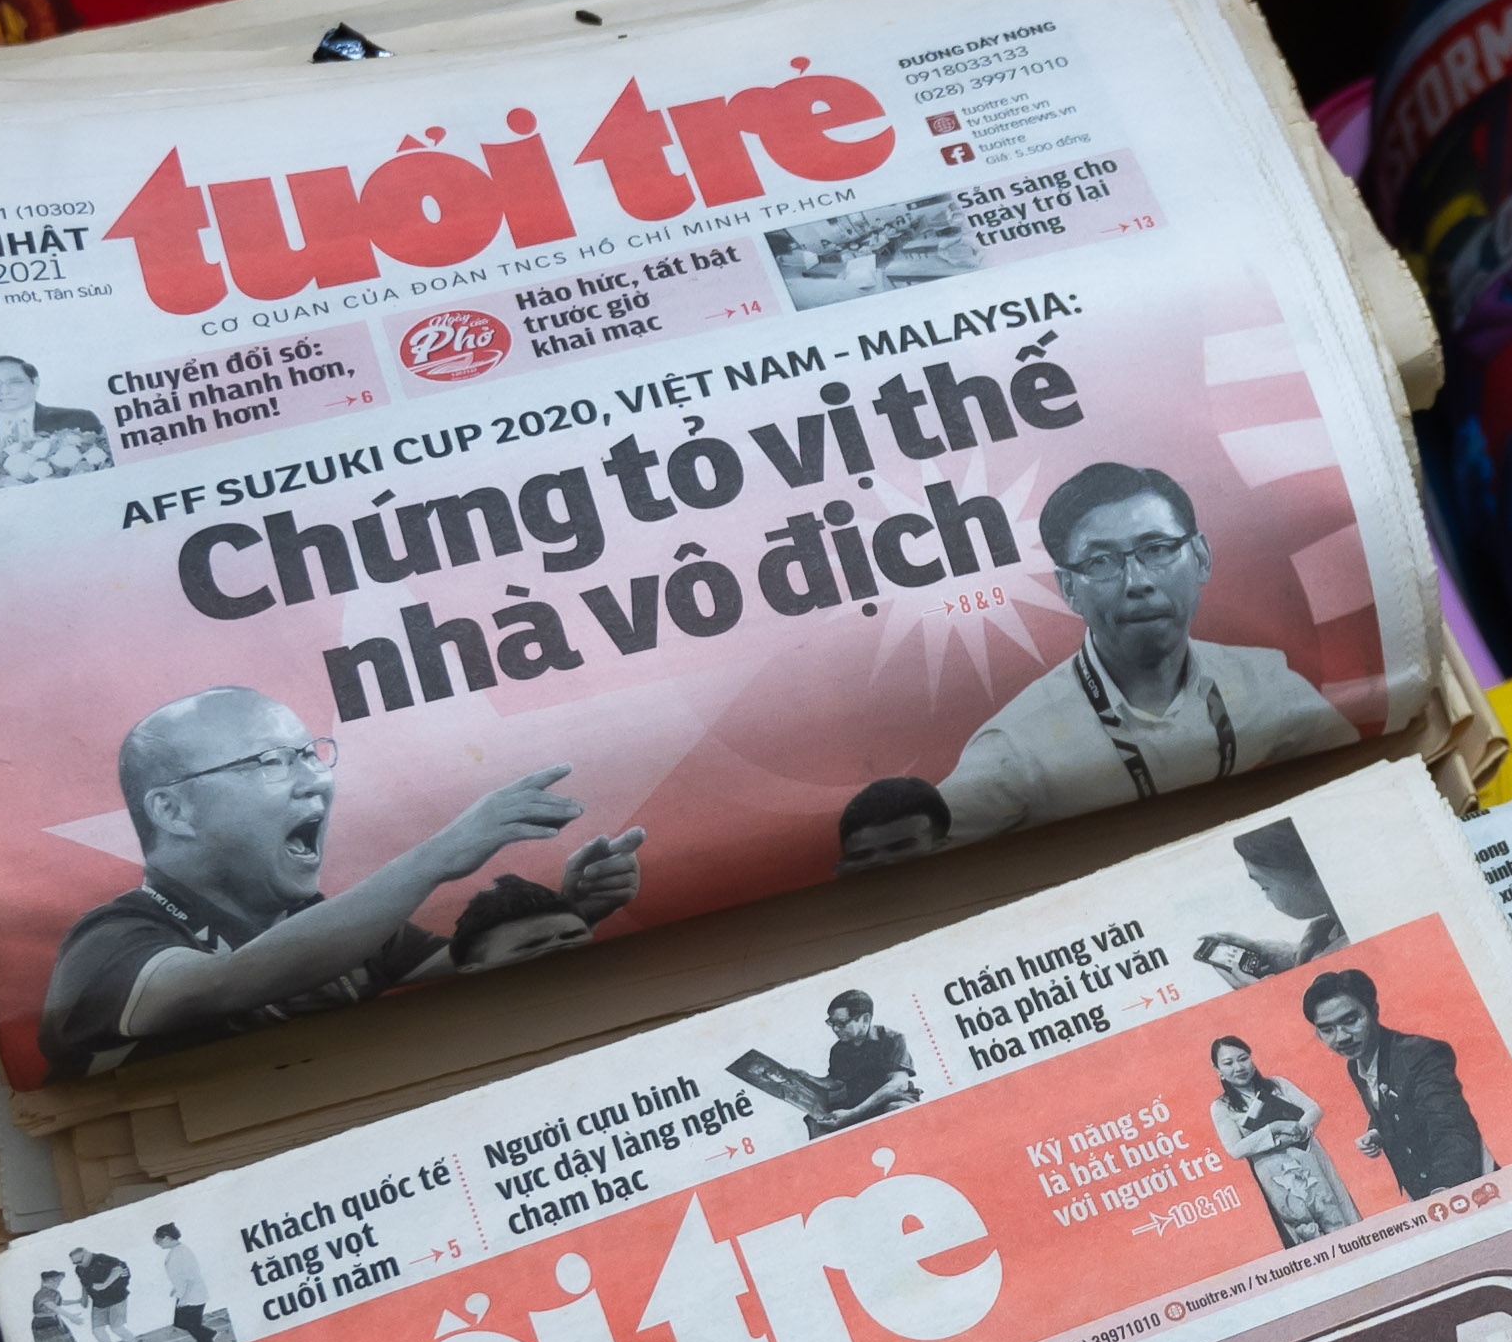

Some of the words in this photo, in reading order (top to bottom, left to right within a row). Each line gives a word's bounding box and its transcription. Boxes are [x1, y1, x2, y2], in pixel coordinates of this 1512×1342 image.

[904, 45, 1030, 86] 0918033133
[15, 200, 96, 221] (10302)
[100, 106, 578, 316] tuổi
[573, 55, 896, 223] trẻ
[200, 316, 239, 337] CƠ
[251, 300, 330, 329] QUAN
[342, 287, 400, 310] CỦA
[410, 268, 488, 296] ĐOÀN
[499, 251, 568, 277] TNCS
[578, 236, 616, 260] HỒ
[627, 225, 672, 249] CHÍ
[681, 210, 751, 237] MINH
[759, 187, 857, 219] TP.HCM
[514, 286, 573, 311] Háo
[575, 272, 640, 297] hức,
[642, 256, 689, 282] tất
[689, 245, 742, 272] bật
[522, 304, 603, 335] trước
[606, 289, 651, 320] giờ
[530, 326, 597, 359] khai
[600, 315, 663, 343] mạc
[107, 357, 220, 396] Chuyển
[225, 346, 274, 375] đổi
[278, 335, 324, 364] số:
[113, 390, 182, 427] phải
[187, 371, 284, 409] nhanh
[287, 360, 356, 387] hơn,
[119, 413, 208, 450] mạnh
[211, 396, 281, 430] hơn!
[121, 484, 206, 530] AFF
[215, 445, 385, 507] SUZUKI
[392, 423, 483, 466] CUP
[490, 398, 612, 445] 2020,
[614, 368, 714, 414] VIỆT
[723, 345, 826, 392] NAM
[857, 291, 1083, 362] MALAYSIA:
[177, 465, 606, 621] Chứng
[601, 414, 745, 522] tỏ
[747, 381, 874, 491] vị
[871, 329, 1085, 461] thế
[321, 583, 586, 724] nhà
[568, 541, 744, 657] vô
[757, 479, 1022, 618] địch
[483, 1116, 572, 1170] Người
[575, 1102, 631, 1136] cựu
[630, 1075, 701, 1118] binh
[494, 1166, 551, 1201] vực
[553, 1145, 607, 1182] dậy
[610, 1120, 681, 1162] làng
[680, 1088, 755, 1138] nghề
[1025, 1136, 1064, 1169] Kỹ
[1067, 1112, 1140, 1156] năng
[1137, 1093, 1171, 1129] số
[1037, 1168, 1071, 1199] là
[1068, 1150, 1122, 1188] bắt
[1118, 1129, 1191, 1169] buộc
[1052, 1191, 1099, 1228] với
[1099, 1163, 1179, 1212] người
[1178, 1146, 1224, 1182] trẻ
[239, 1200, 337, 1254] Khách
[341, 1173, 416, 1220] quốc
[417, 1156, 452, 1191] tế
[507, 1190, 591, 1236] chạm
[590, 1169, 650, 1206] bạc
[249, 1244, 325, 1287] tăng
[324, 1222, 380, 1261] vọt
[262, 1275, 328, 1322] cuối
[331, 1256, 401, 1298] năm
